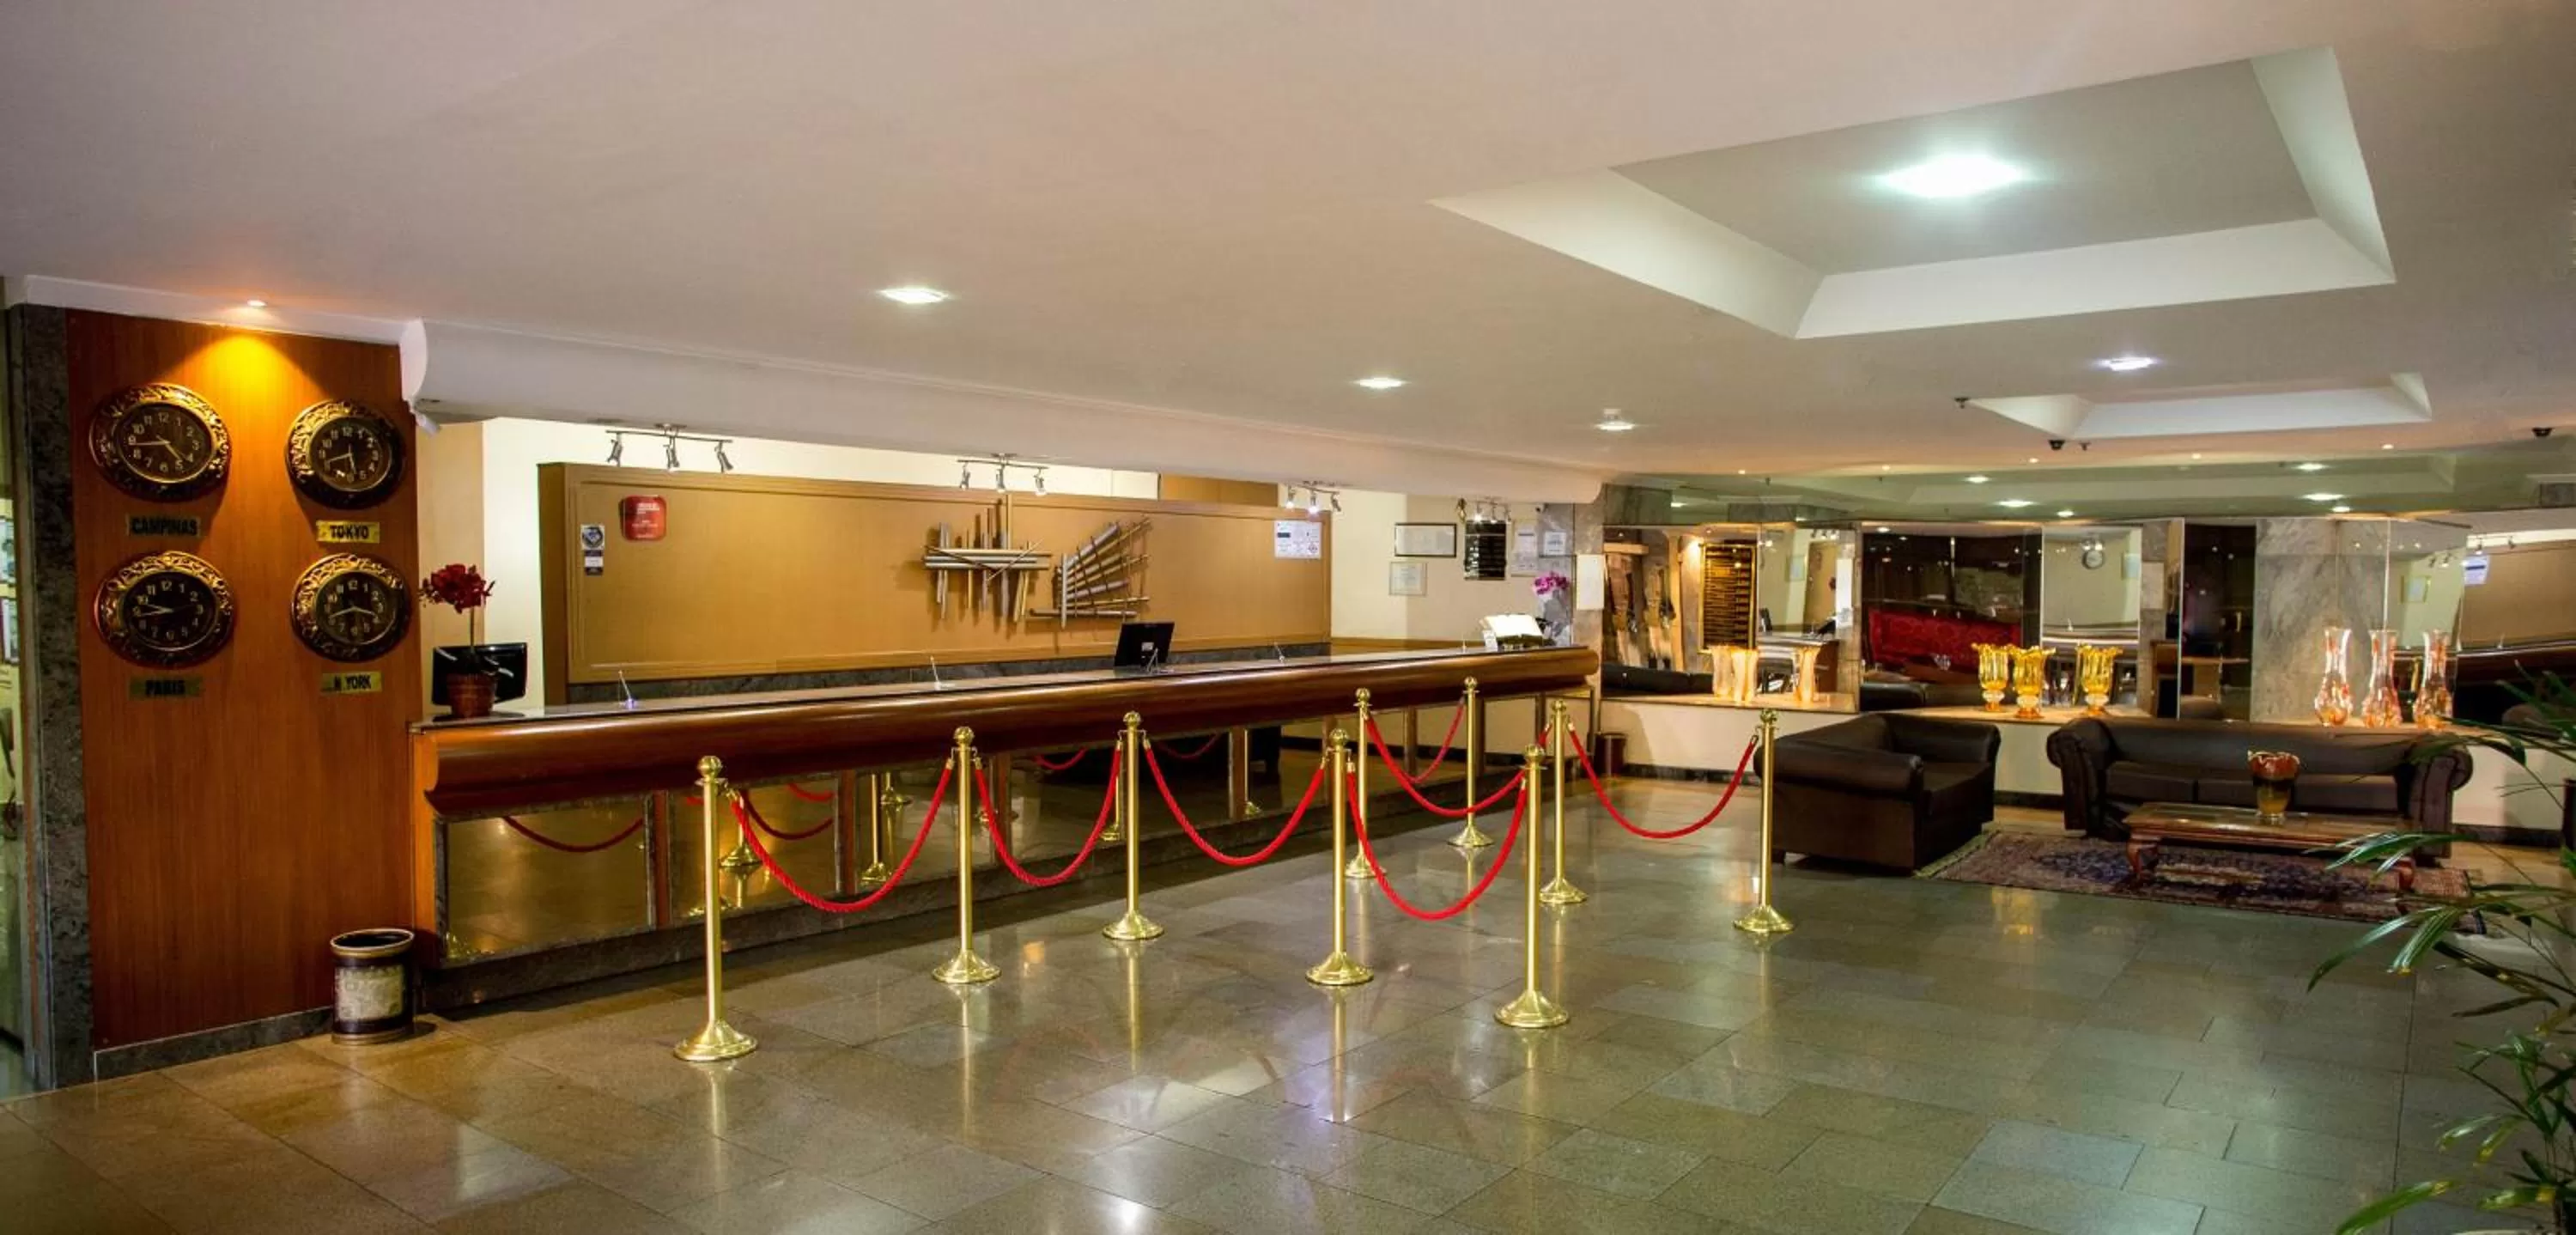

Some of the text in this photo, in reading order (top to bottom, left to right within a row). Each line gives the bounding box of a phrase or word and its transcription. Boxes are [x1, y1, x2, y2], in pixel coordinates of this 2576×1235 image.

[143, 416, 153, 426] 11
[158, 412, 169, 423] 12
[177, 417, 181, 426] 1
[132, 423, 145, 435] 10
[186, 426, 194, 437] 2
[192, 440, 200, 451] 3
[144, 457, 153, 467] 7
[186, 453, 194, 463] 4
[160, 461, 169, 472] 6
[175, 459, 183, 471] 5
[131, 518, 197, 535] CAMPINAS
[330, 525, 369, 539] TOKYO
[146, 584, 156, 595] 11
[161, 580, 172, 591] 12
[179, 583, 185, 593] 1
[190, 591, 198, 602] 2
[145, 679, 185, 695] PARIS
